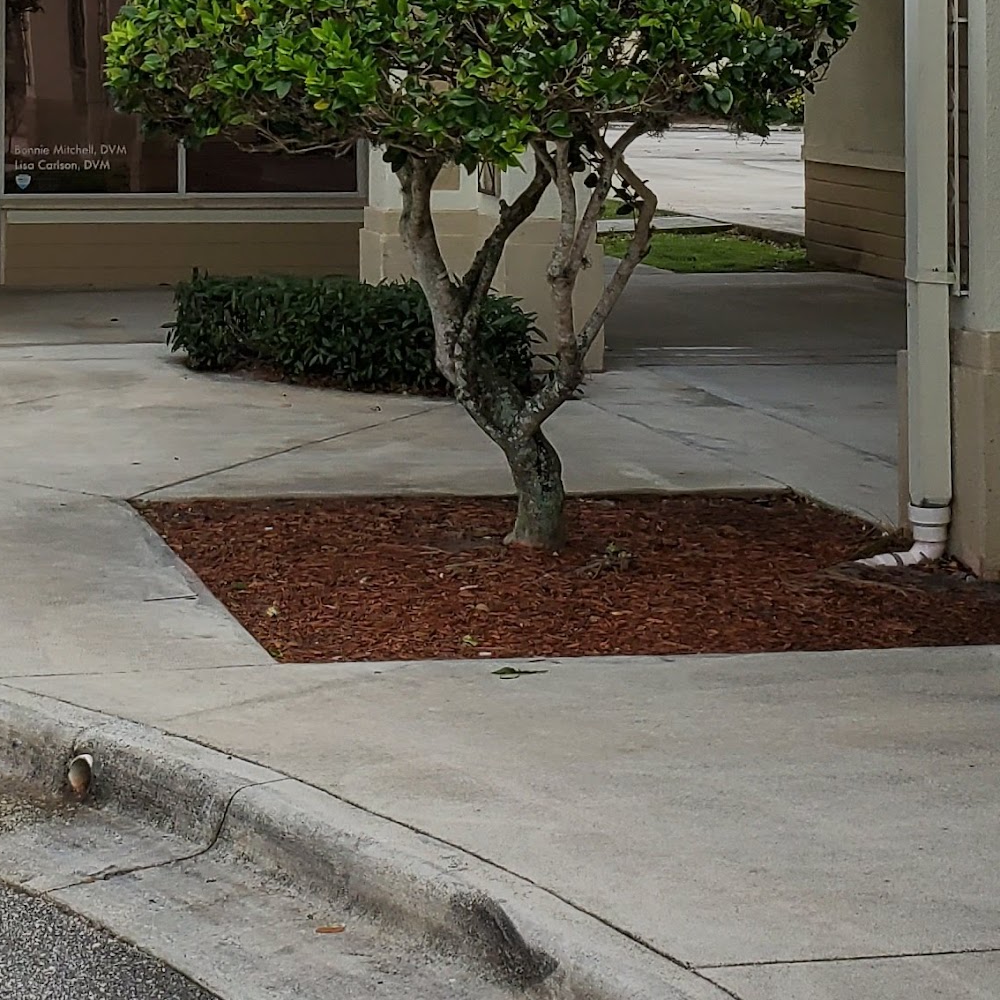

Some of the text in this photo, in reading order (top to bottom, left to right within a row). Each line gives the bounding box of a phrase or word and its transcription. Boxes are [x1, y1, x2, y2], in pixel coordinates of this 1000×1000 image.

[14, 145, 50, 155] Bonnie
[101, 144, 127, 155] DVM
[15, 159, 110, 171] Lisa Carlson, DVM
